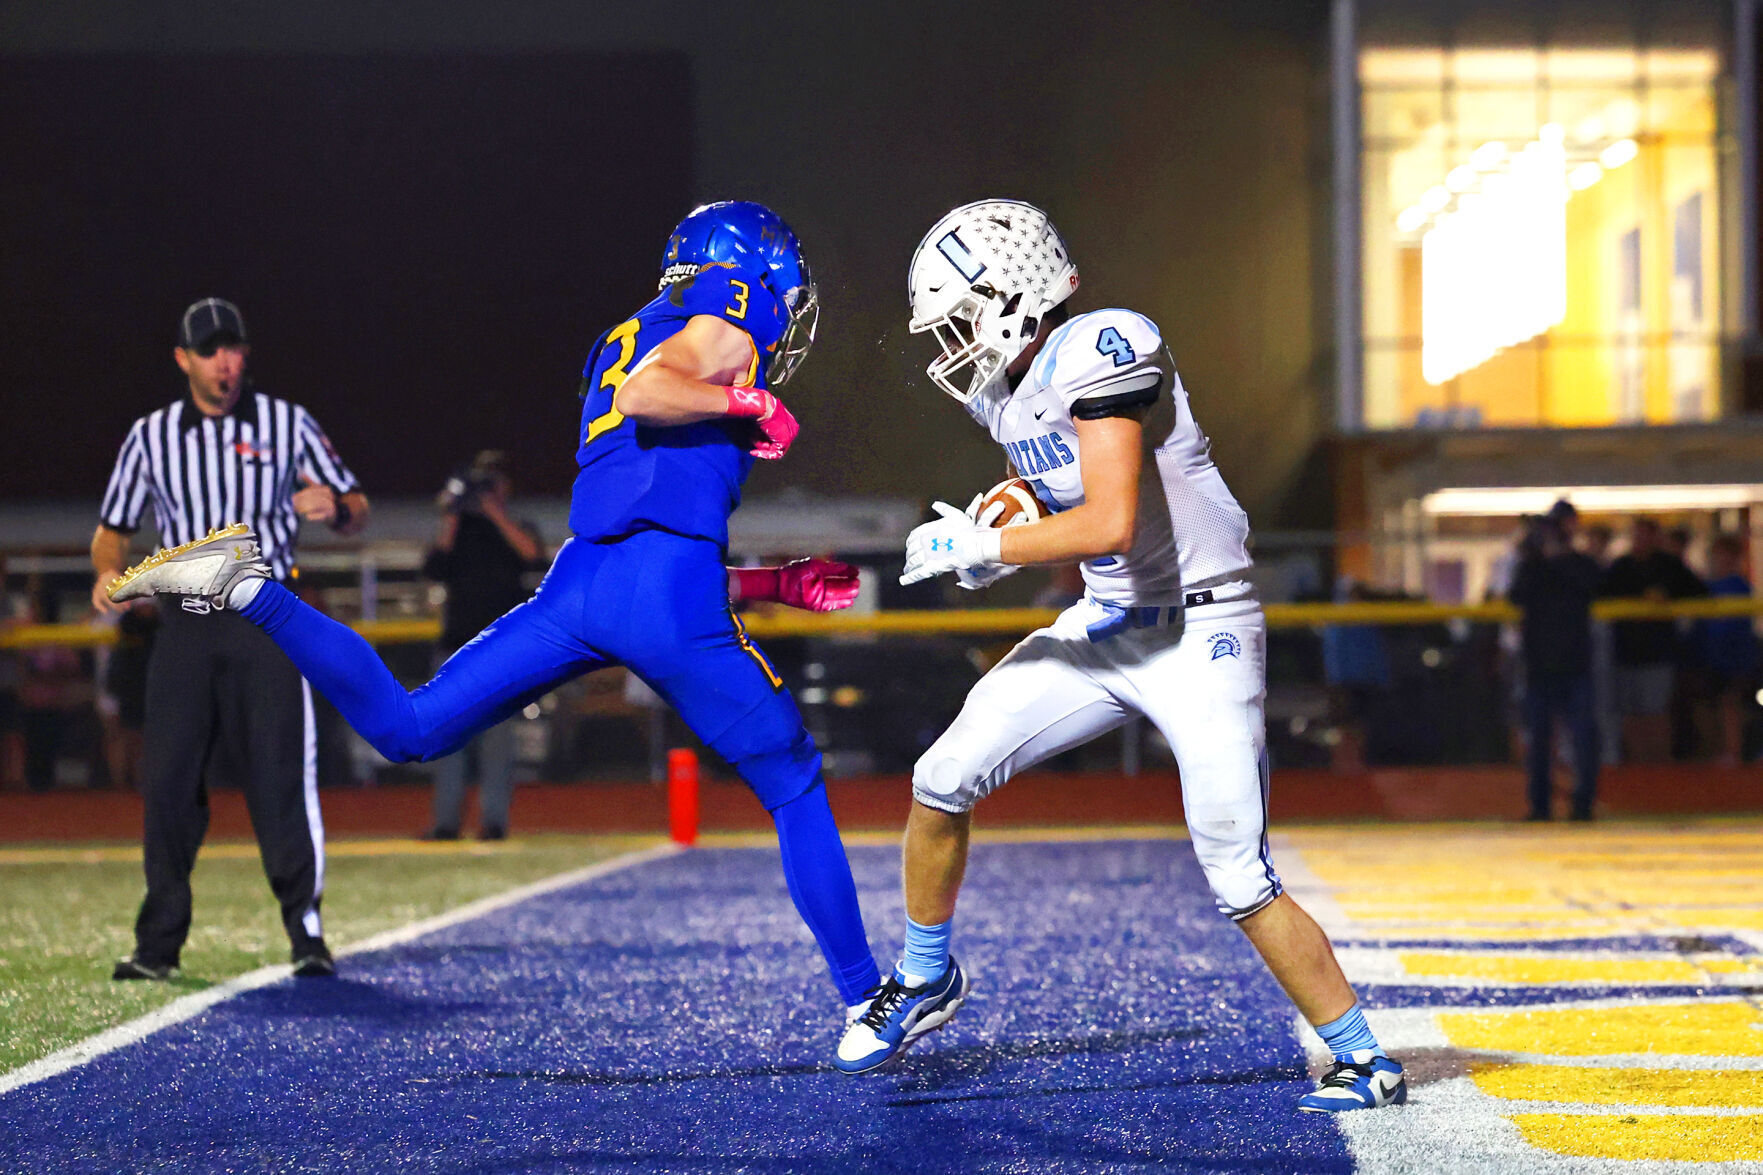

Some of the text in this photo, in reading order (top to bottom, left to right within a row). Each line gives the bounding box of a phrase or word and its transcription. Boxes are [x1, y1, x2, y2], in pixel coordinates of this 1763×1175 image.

[725, 279, 749, 320] 3
[1096, 326, 1136, 367] 4
[586, 317, 641, 445] 3
[1195, 594, 1204, 604] S
